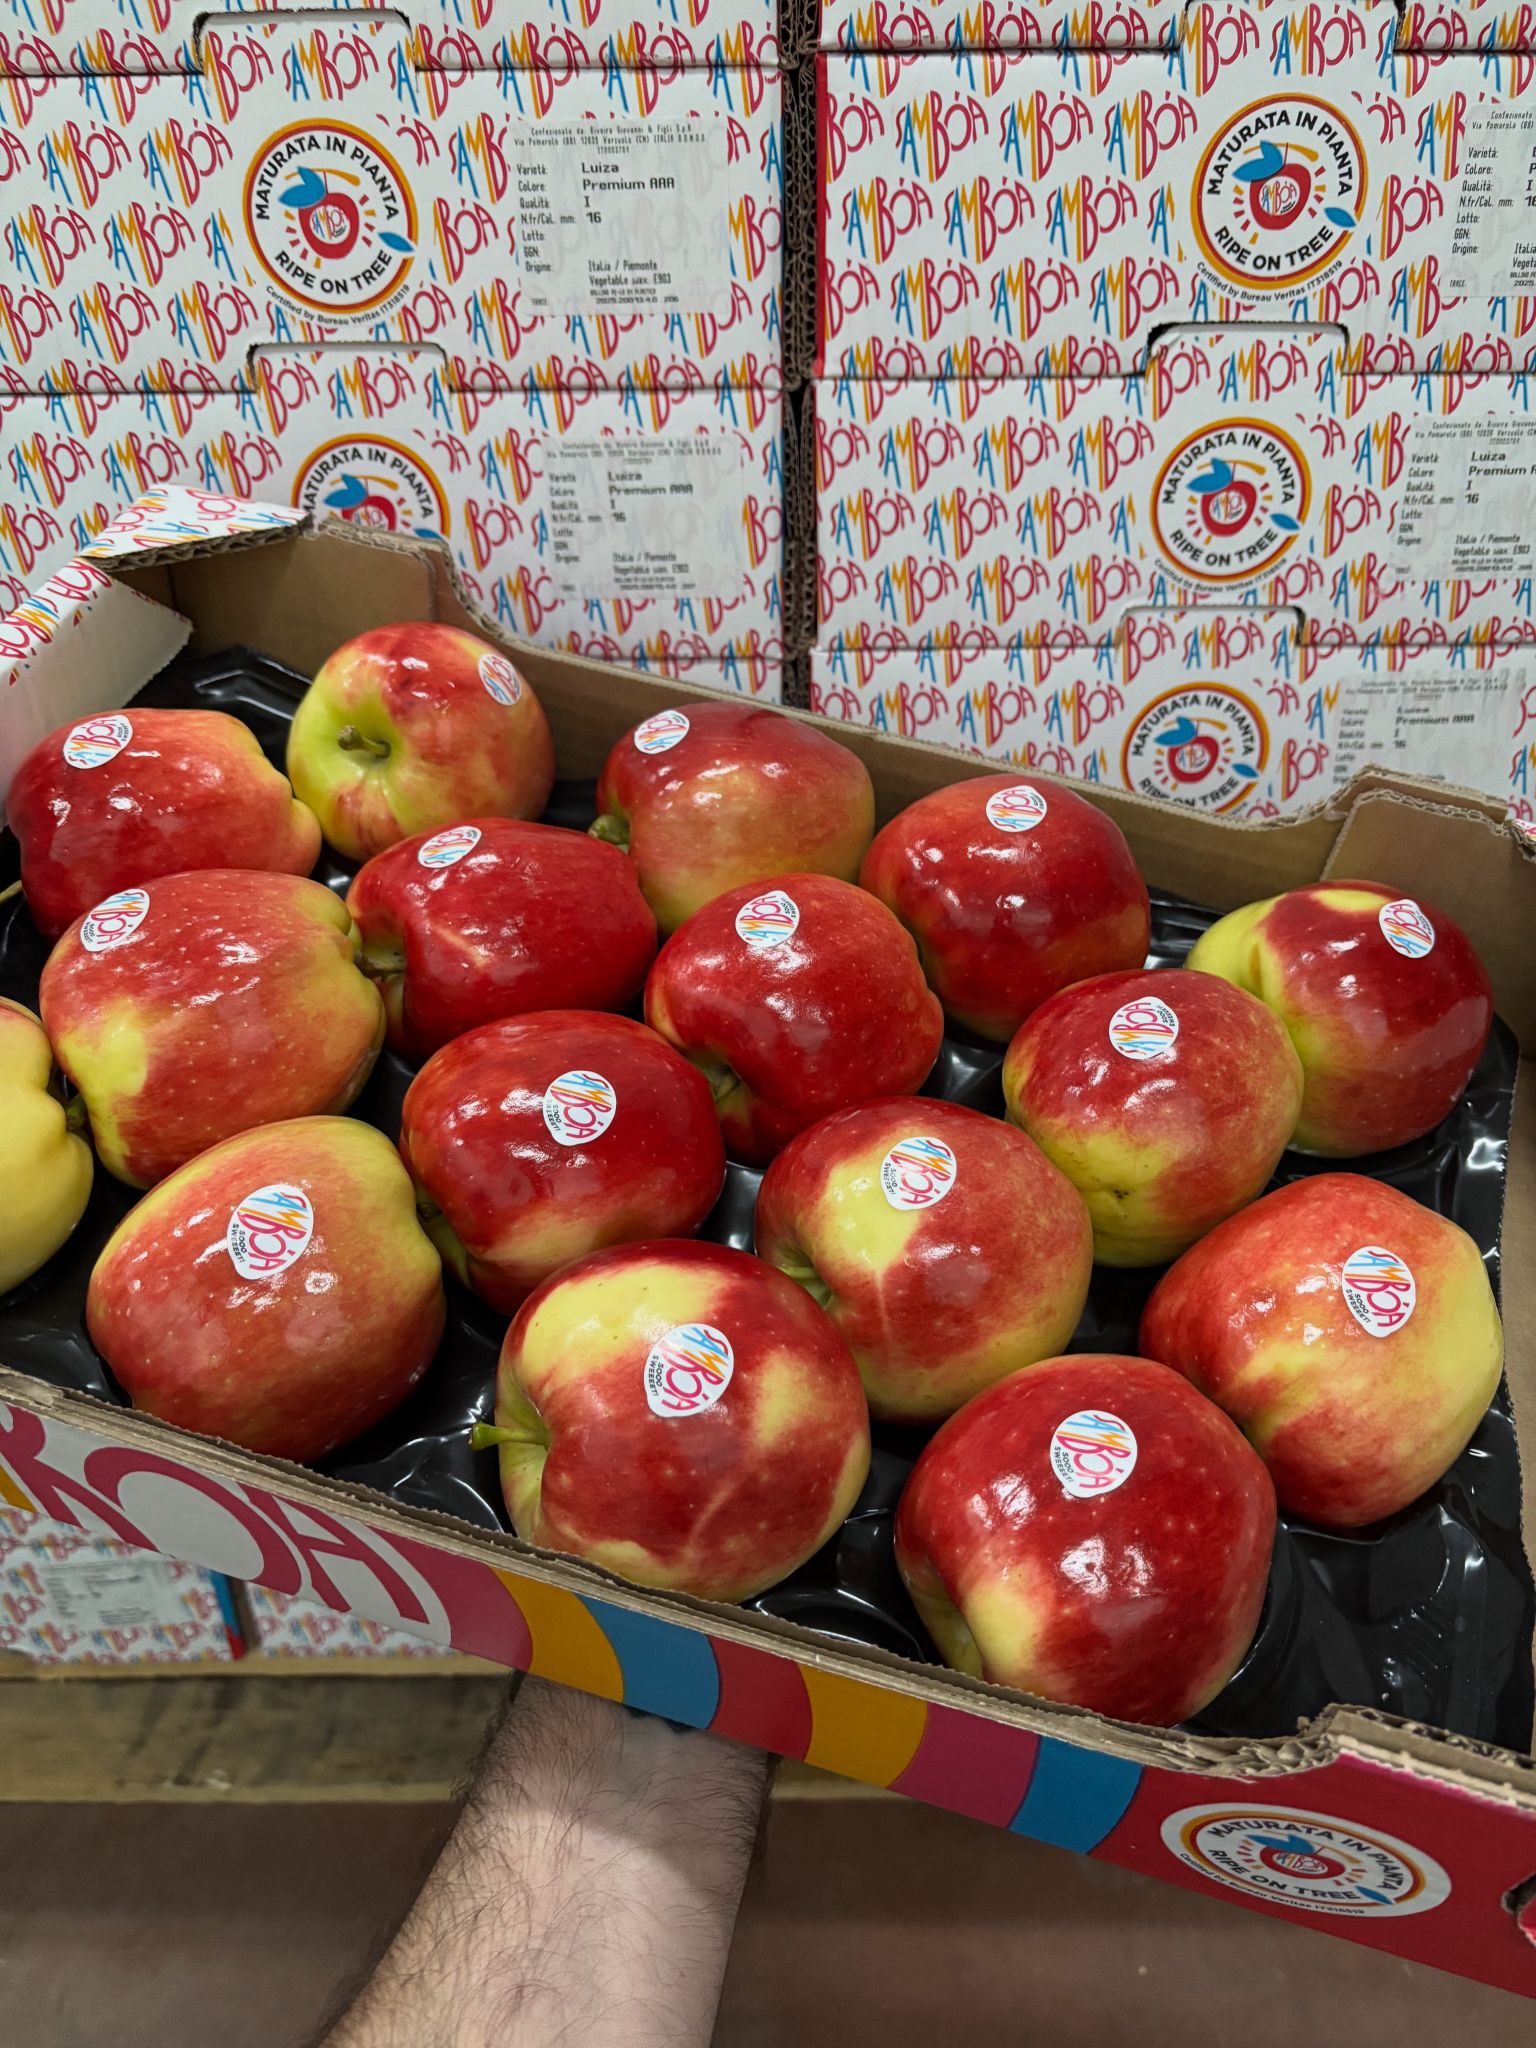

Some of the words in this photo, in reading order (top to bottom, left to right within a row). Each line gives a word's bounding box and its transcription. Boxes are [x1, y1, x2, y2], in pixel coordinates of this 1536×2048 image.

[581, 161, 620, 174] Luiza
[1207, 110, 1291, 196] MATURATA
[1295, 110, 1318, 131] IN
[1317, 122, 1353, 197] PIANTA
[255, 135, 321, 220] MATURATA
[326, 135, 347, 151] IN
[350, 147, 400, 220] PIANTA
[582, 178, 646, 191] Premium
[649, 177, 675, 190] AAA
[586, 212, 602, 224] 16
[588, 260, 611, 272] Italia
[623, 259, 657, 271] Piemonte
[1214, 225, 1252, 265] RIPE
[1252, 254, 1281, 272] ON
[1285, 225, 1334, 270] TREE
[275, 250, 316, 289] RIPE
[321, 279, 350, 295] ON
[351, 249, 393, 291] TREE
[589, 275, 628, 288] Vegetable
[1196, 261, 1228, 293] Certified
[1228, 286, 1239, 298] by
[1240, 290, 1272, 302] Bureau
[1273, 287, 1305, 301] Veritas
[265, 284, 302, 315] Certified
[303, 310, 315, 322] by
[317, 314, 350, 326] Bureau
[350, 309, 380, 325] Veritas
[1162, 431, 1237, 504] MATURATA
[1242, 432, 1262, 448] IN
[1262, 442, 1295, 505] PIANTA
[1468, 464, 1526, 476] Premium
[1471, 451, 1506, 462] Luiza
[368, 447, 388, 464] IN
[390, 457, 435, 519] PIANTA
[608, 471, 642, 482] Luiza
[609, 486, 666, 495] Premium
[1465, 493, 1479, 504] 16
[1169, 529, 1203, 563] RIPE
[1205, 553, 1231, 566] ON
[1234, 528, 1279, 567] TREE
[1131, 694, 1201, 757] MATURATA
[1205, 695, 1224, 709] IN
[1223, 703, 1255, 757] PIANTA
[1200, 776, 1239, 807] TREE
[1206, 1819, 1335, 1841] MATURATA
[1341, 1838, 1371, 1853] IN
[1366, 1845, 1405, 1892] PIANTA
[1208, 1848, 1250, 1876] RIPE
[1250, 1874, 1289, 1891] ON
[1292, 1885, 1362, 1901] TREE
